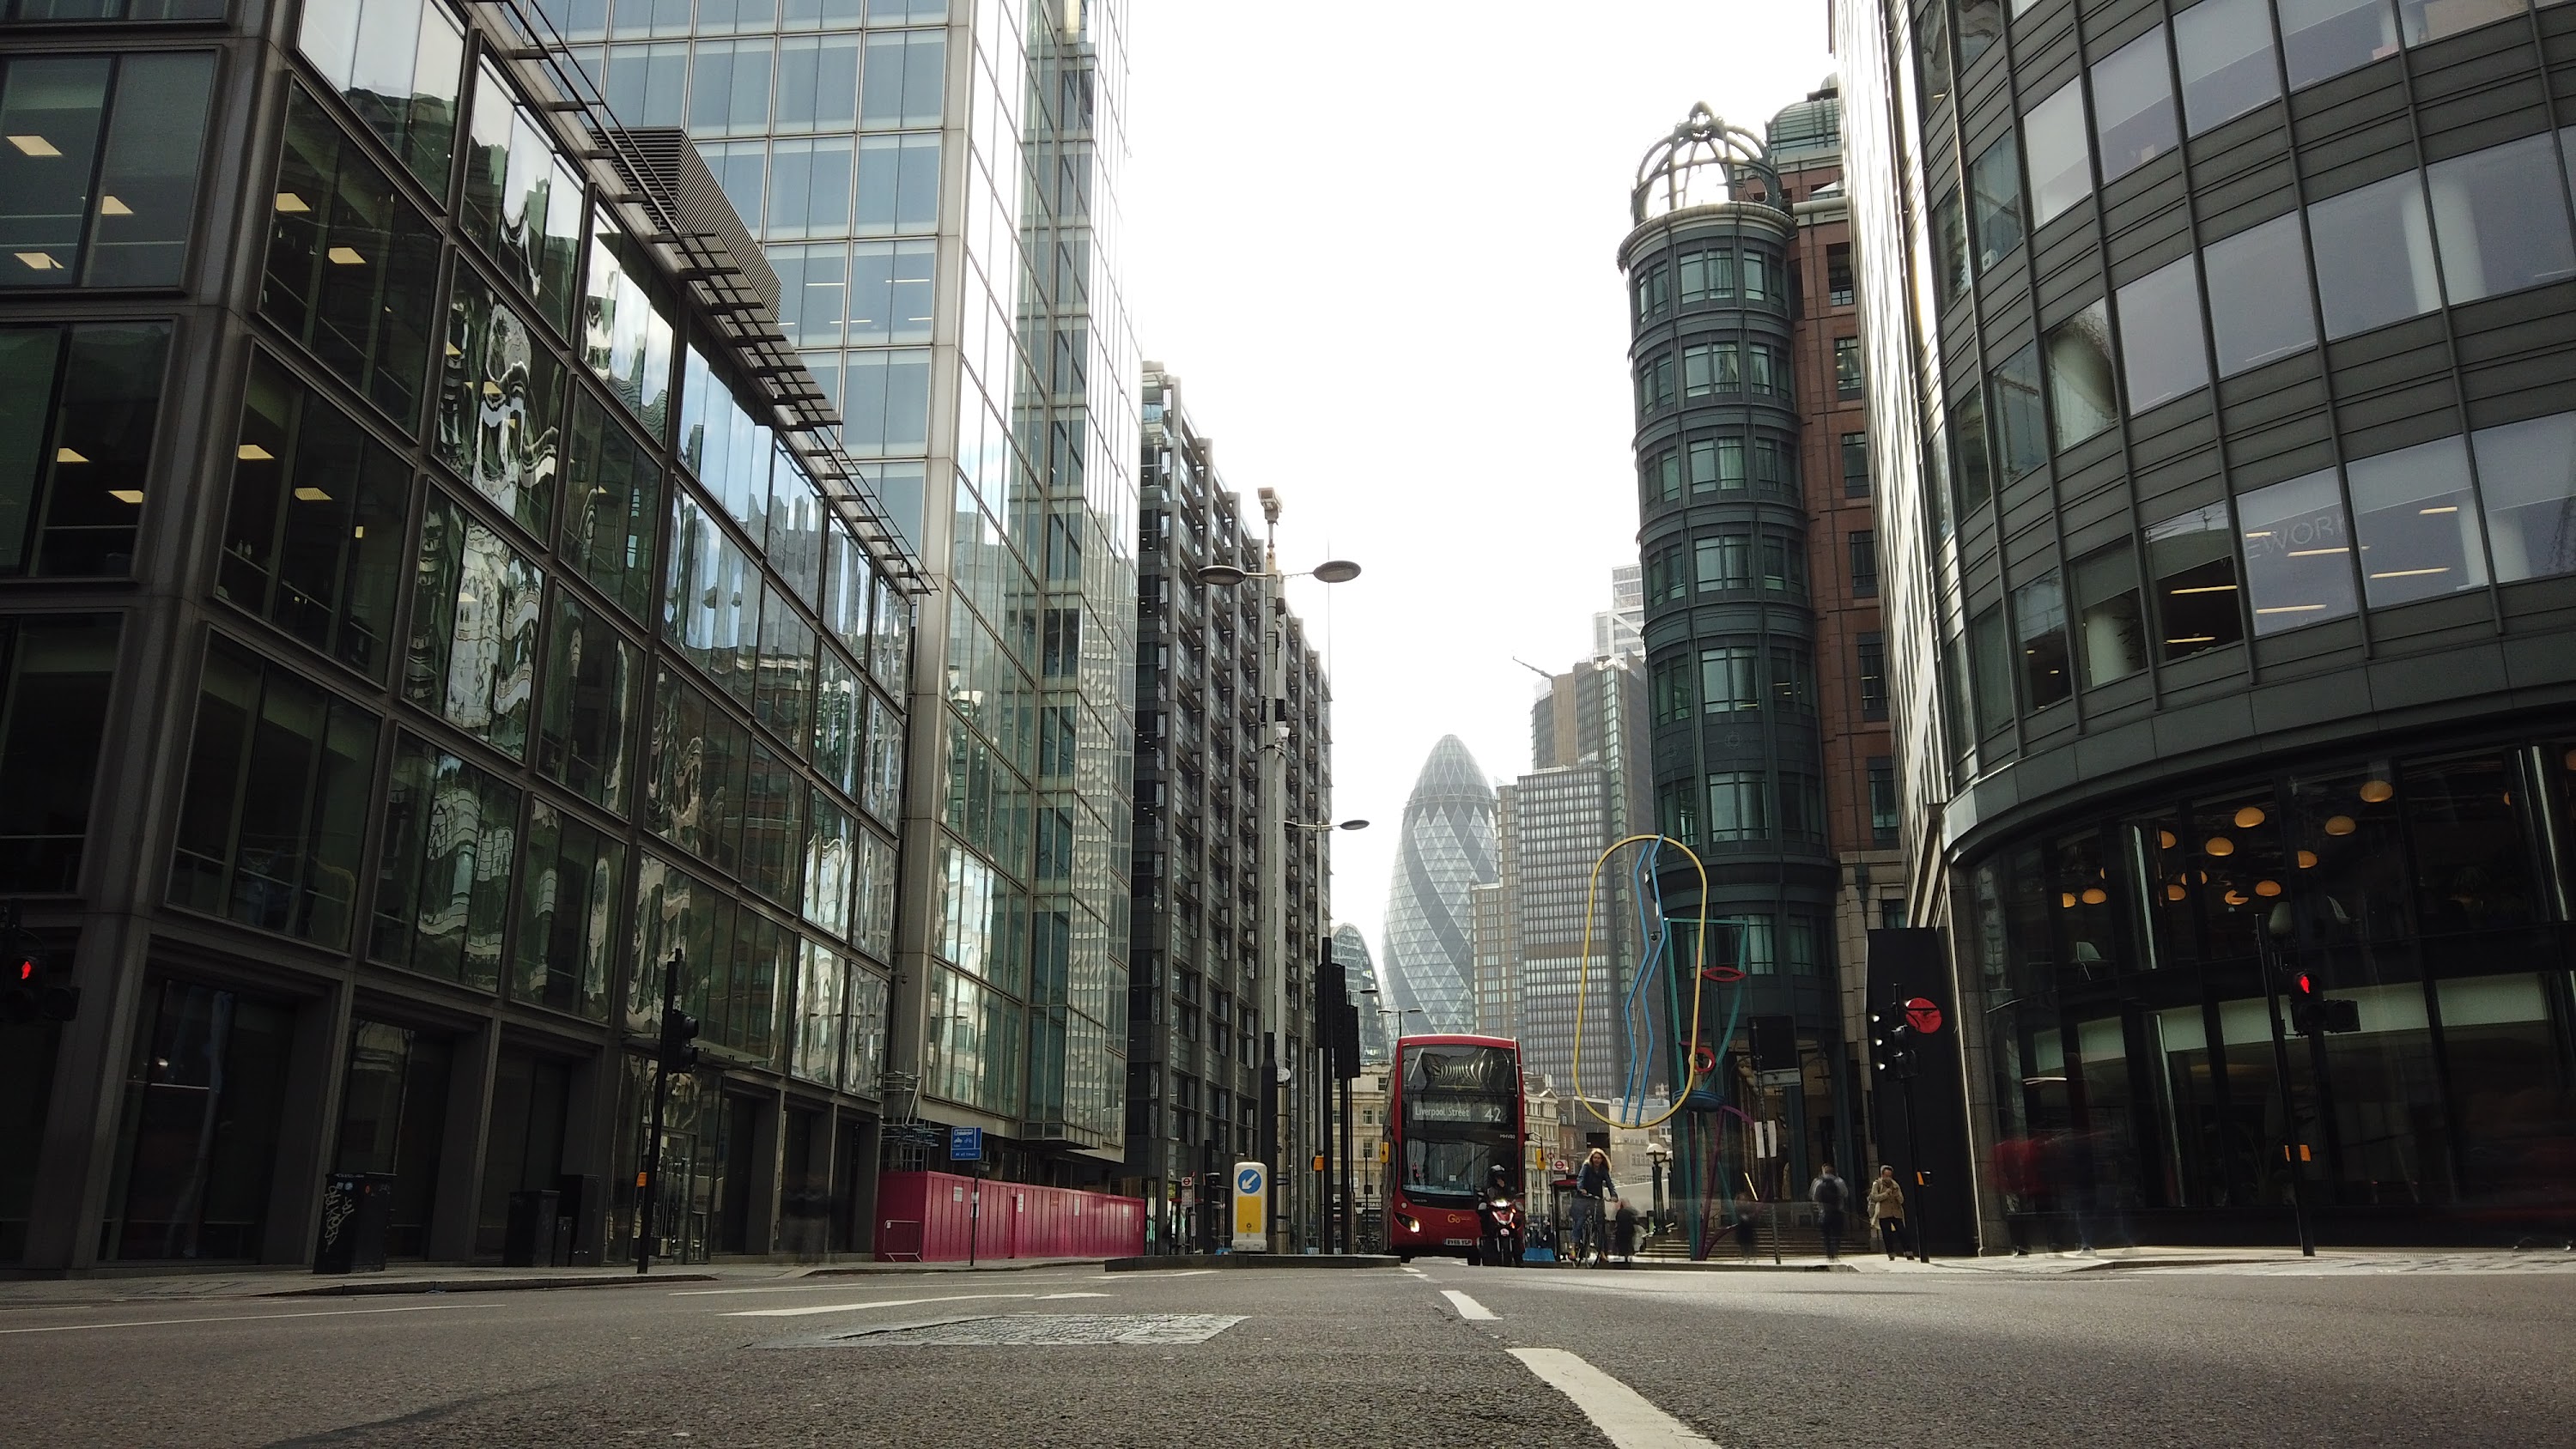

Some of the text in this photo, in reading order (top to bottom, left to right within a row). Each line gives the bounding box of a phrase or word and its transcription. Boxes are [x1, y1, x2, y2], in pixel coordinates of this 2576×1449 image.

[1415, 1106, 1469, 1118] Liverpool Street
[1484, 1107, 1501, 1121] 42
[1447, 1213, 1461, 1224] Go
